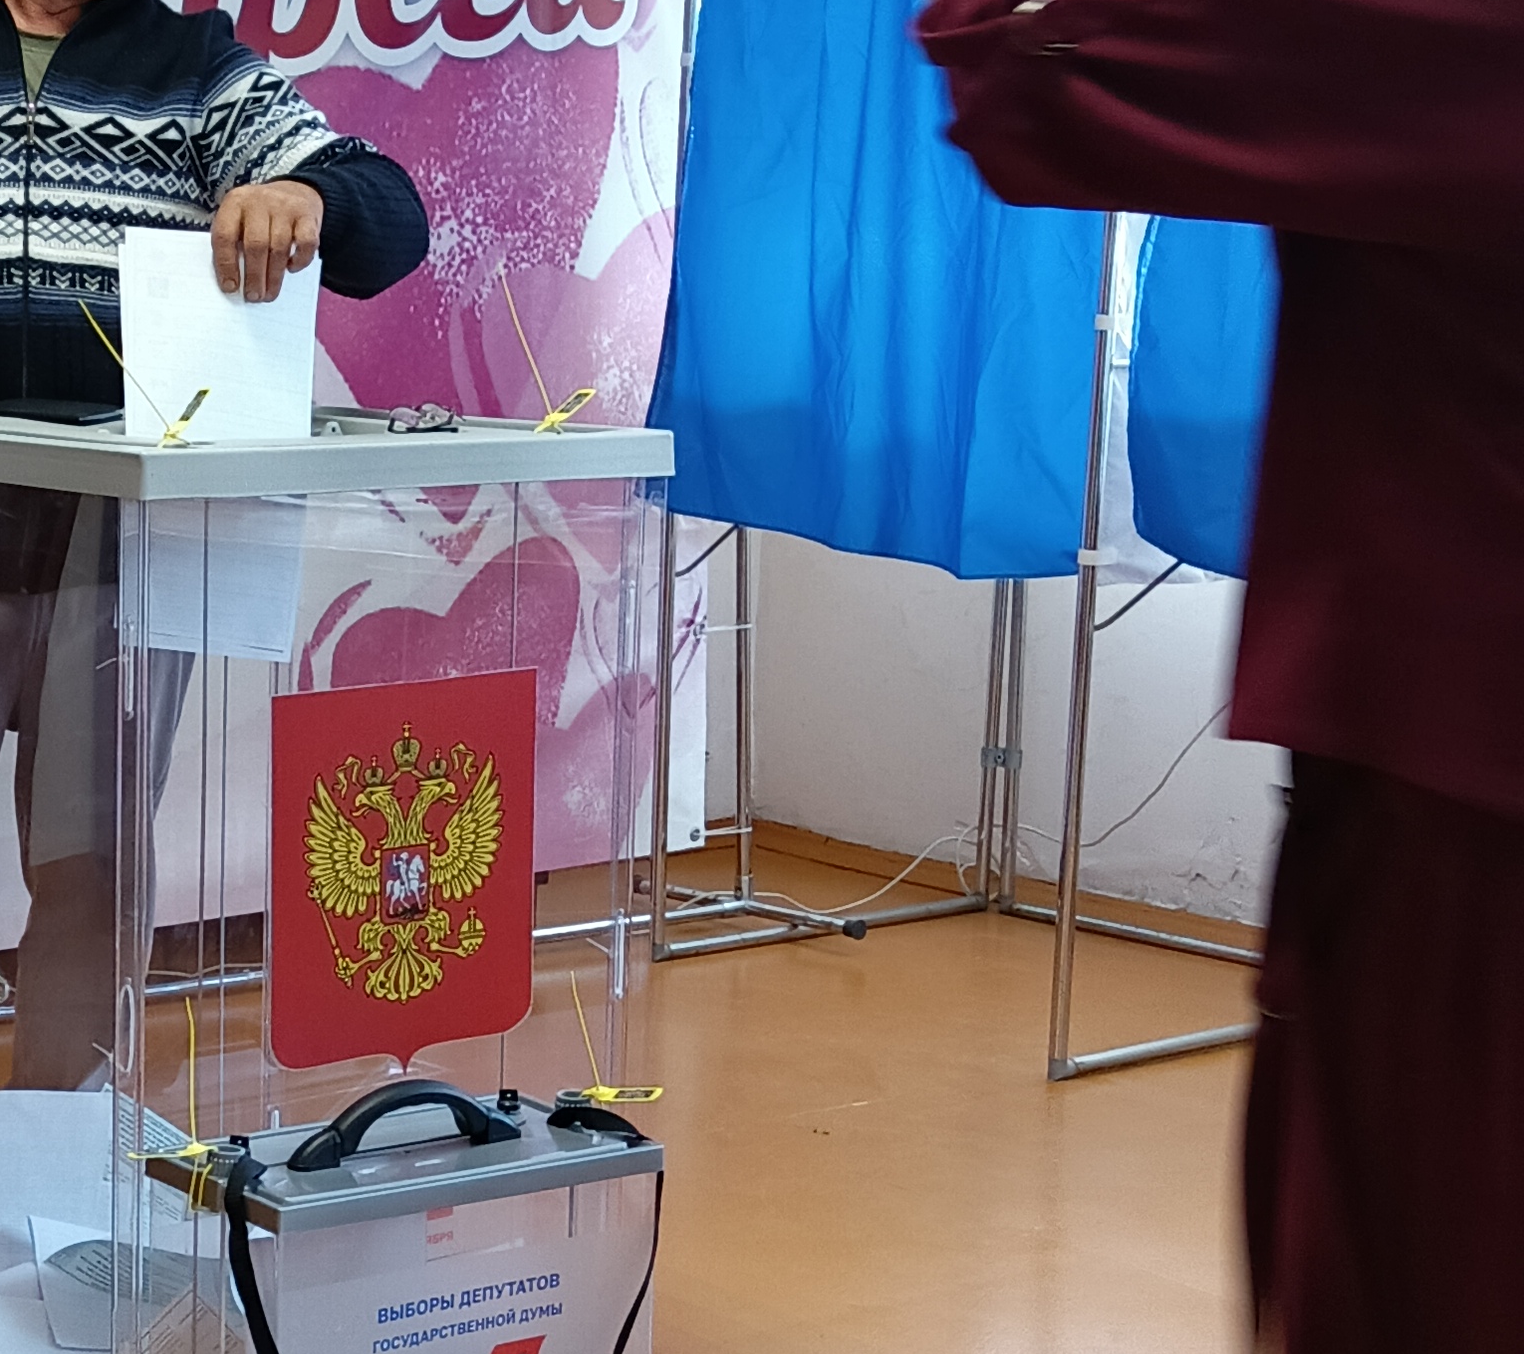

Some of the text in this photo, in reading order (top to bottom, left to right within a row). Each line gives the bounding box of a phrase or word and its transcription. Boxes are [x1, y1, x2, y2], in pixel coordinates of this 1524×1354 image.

[377, 1273, 561, 1324] ВЫБОРЫ ДЕПУТАТОВ
[372, 1302, 563, 1354] ГОСУДАРСТВЕННОЙ ДУМЫ
